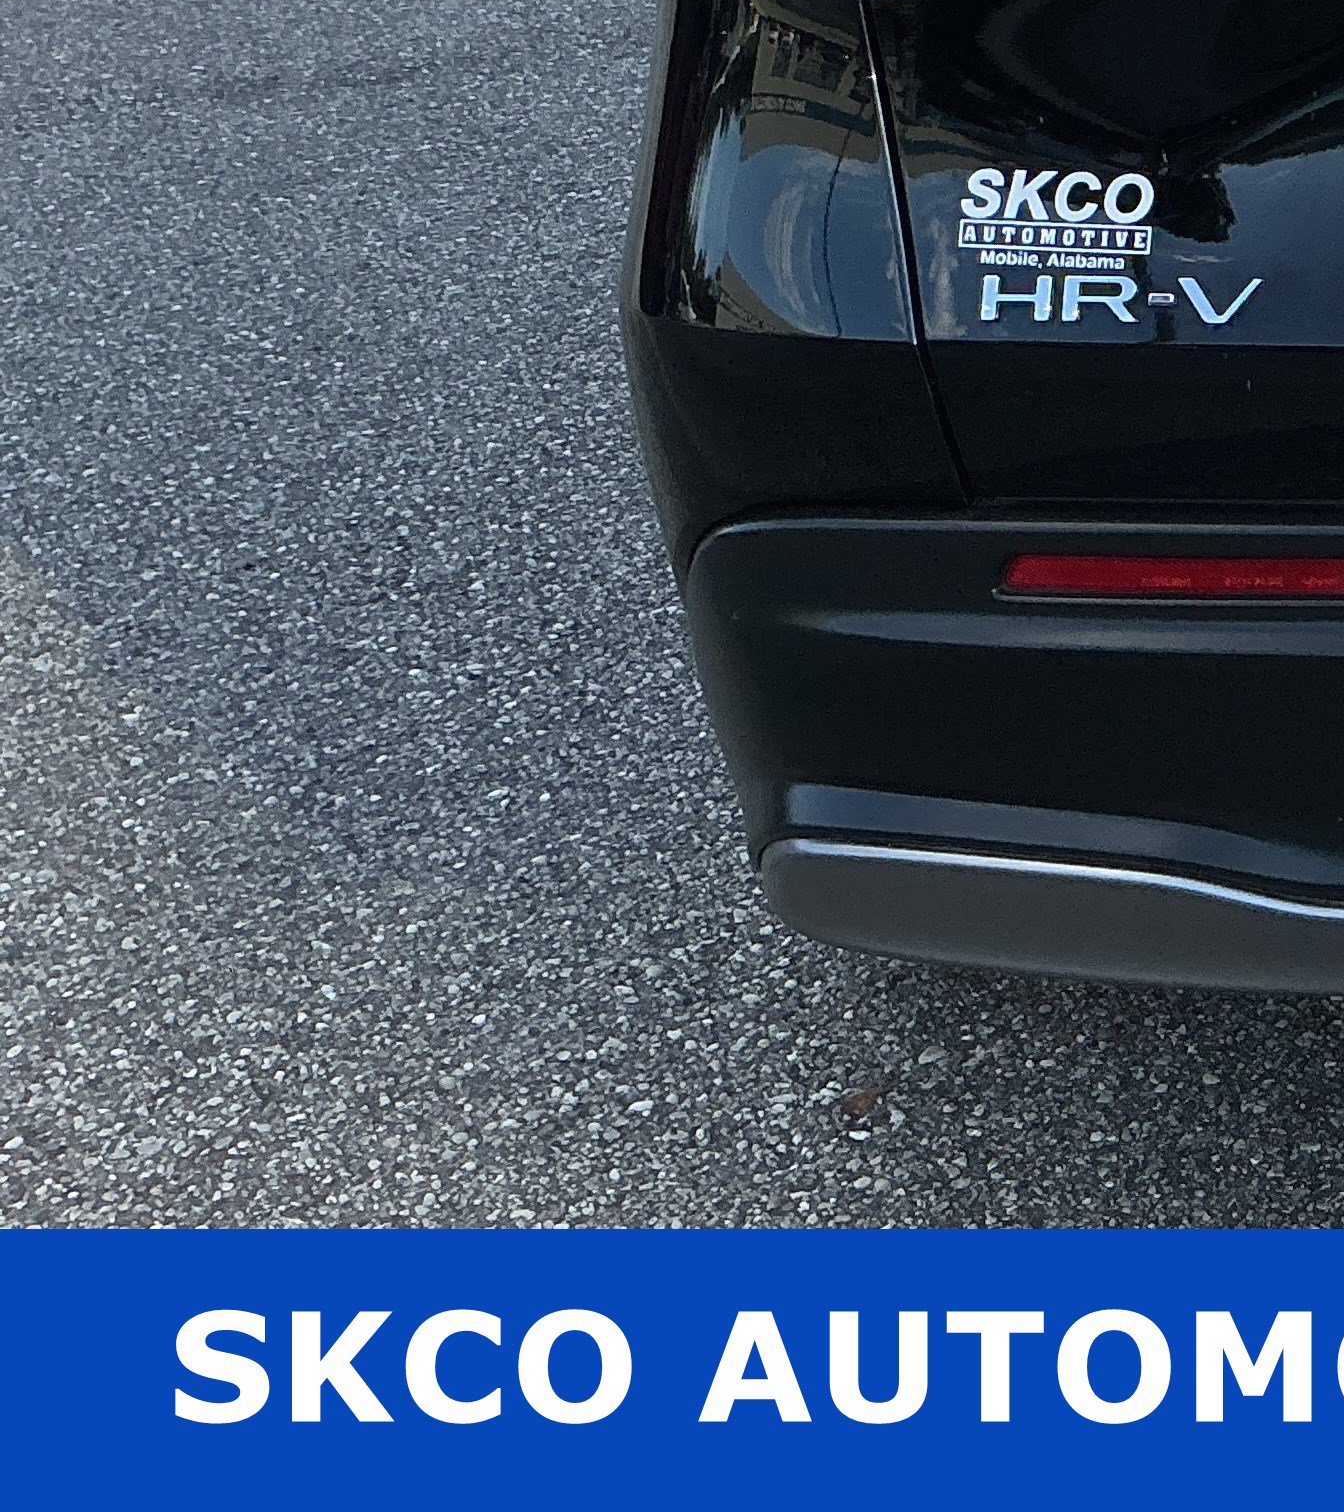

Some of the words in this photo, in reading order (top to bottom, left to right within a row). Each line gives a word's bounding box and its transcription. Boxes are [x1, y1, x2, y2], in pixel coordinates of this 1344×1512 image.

[960, 167, 1155, 224] SKCO
[963, 225, 1148, 249] AUTOMOTIVE
[979, 249, 1043, 269] Mobile,
[1047, 252, 1126, 270] Alabama
[980, 274, 1265, 324] HR-V
